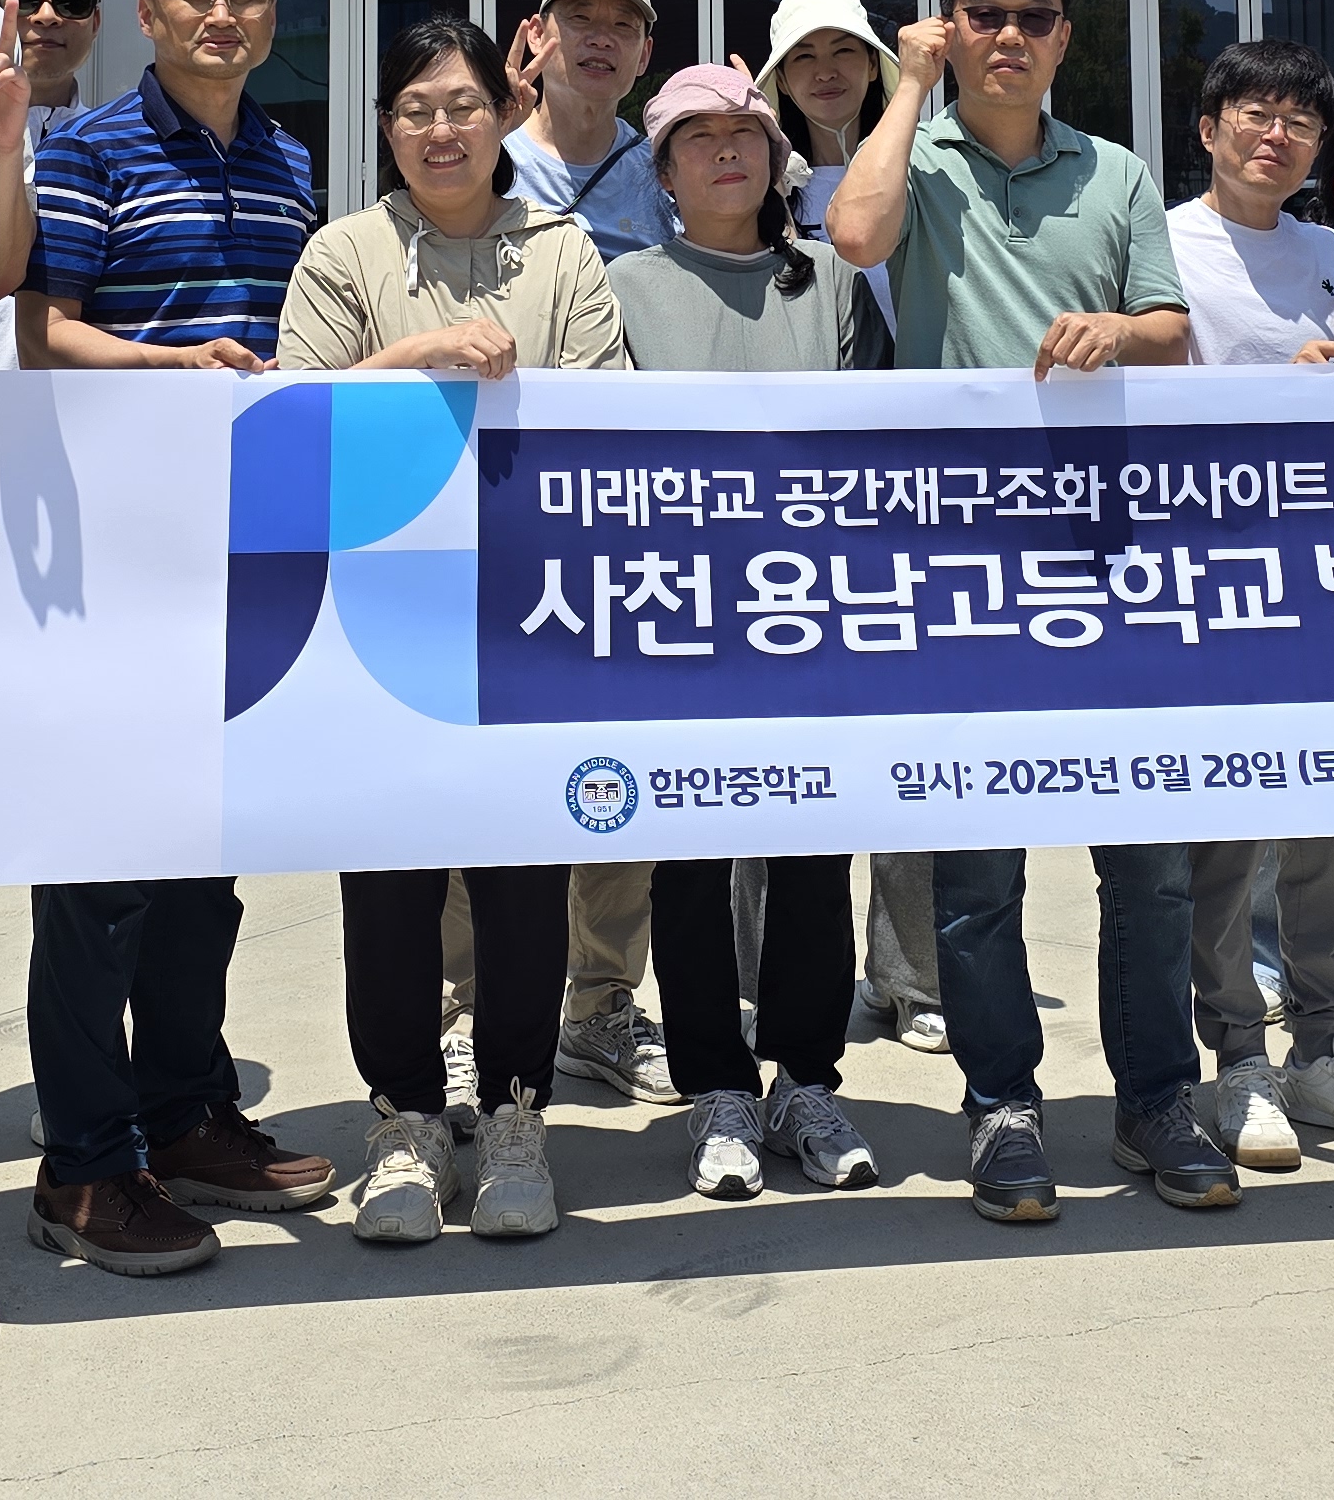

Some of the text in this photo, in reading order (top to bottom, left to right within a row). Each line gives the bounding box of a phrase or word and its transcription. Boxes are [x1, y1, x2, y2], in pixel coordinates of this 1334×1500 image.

[539, 466, 764, 527] 미래학교
[775, 463, 1108, 528] 공간재구조화
[1119, 459, 1334, 521] 인사이트
[519, 551, 715, 658] 사천
[736, 544, 1301, 655] 용남고등학교
[579, 758, 618, 772] MIDDLE
[648, 765, 837, 809] 함안중학교
[890, 761, 974, 801] 일시:
[984, 756, 1120, 795] 2025년
[1130, 754, 1192, 793] 6월
[1201, 751, 1288, 789] 28일
[592, 805, 613, 813] 1951
